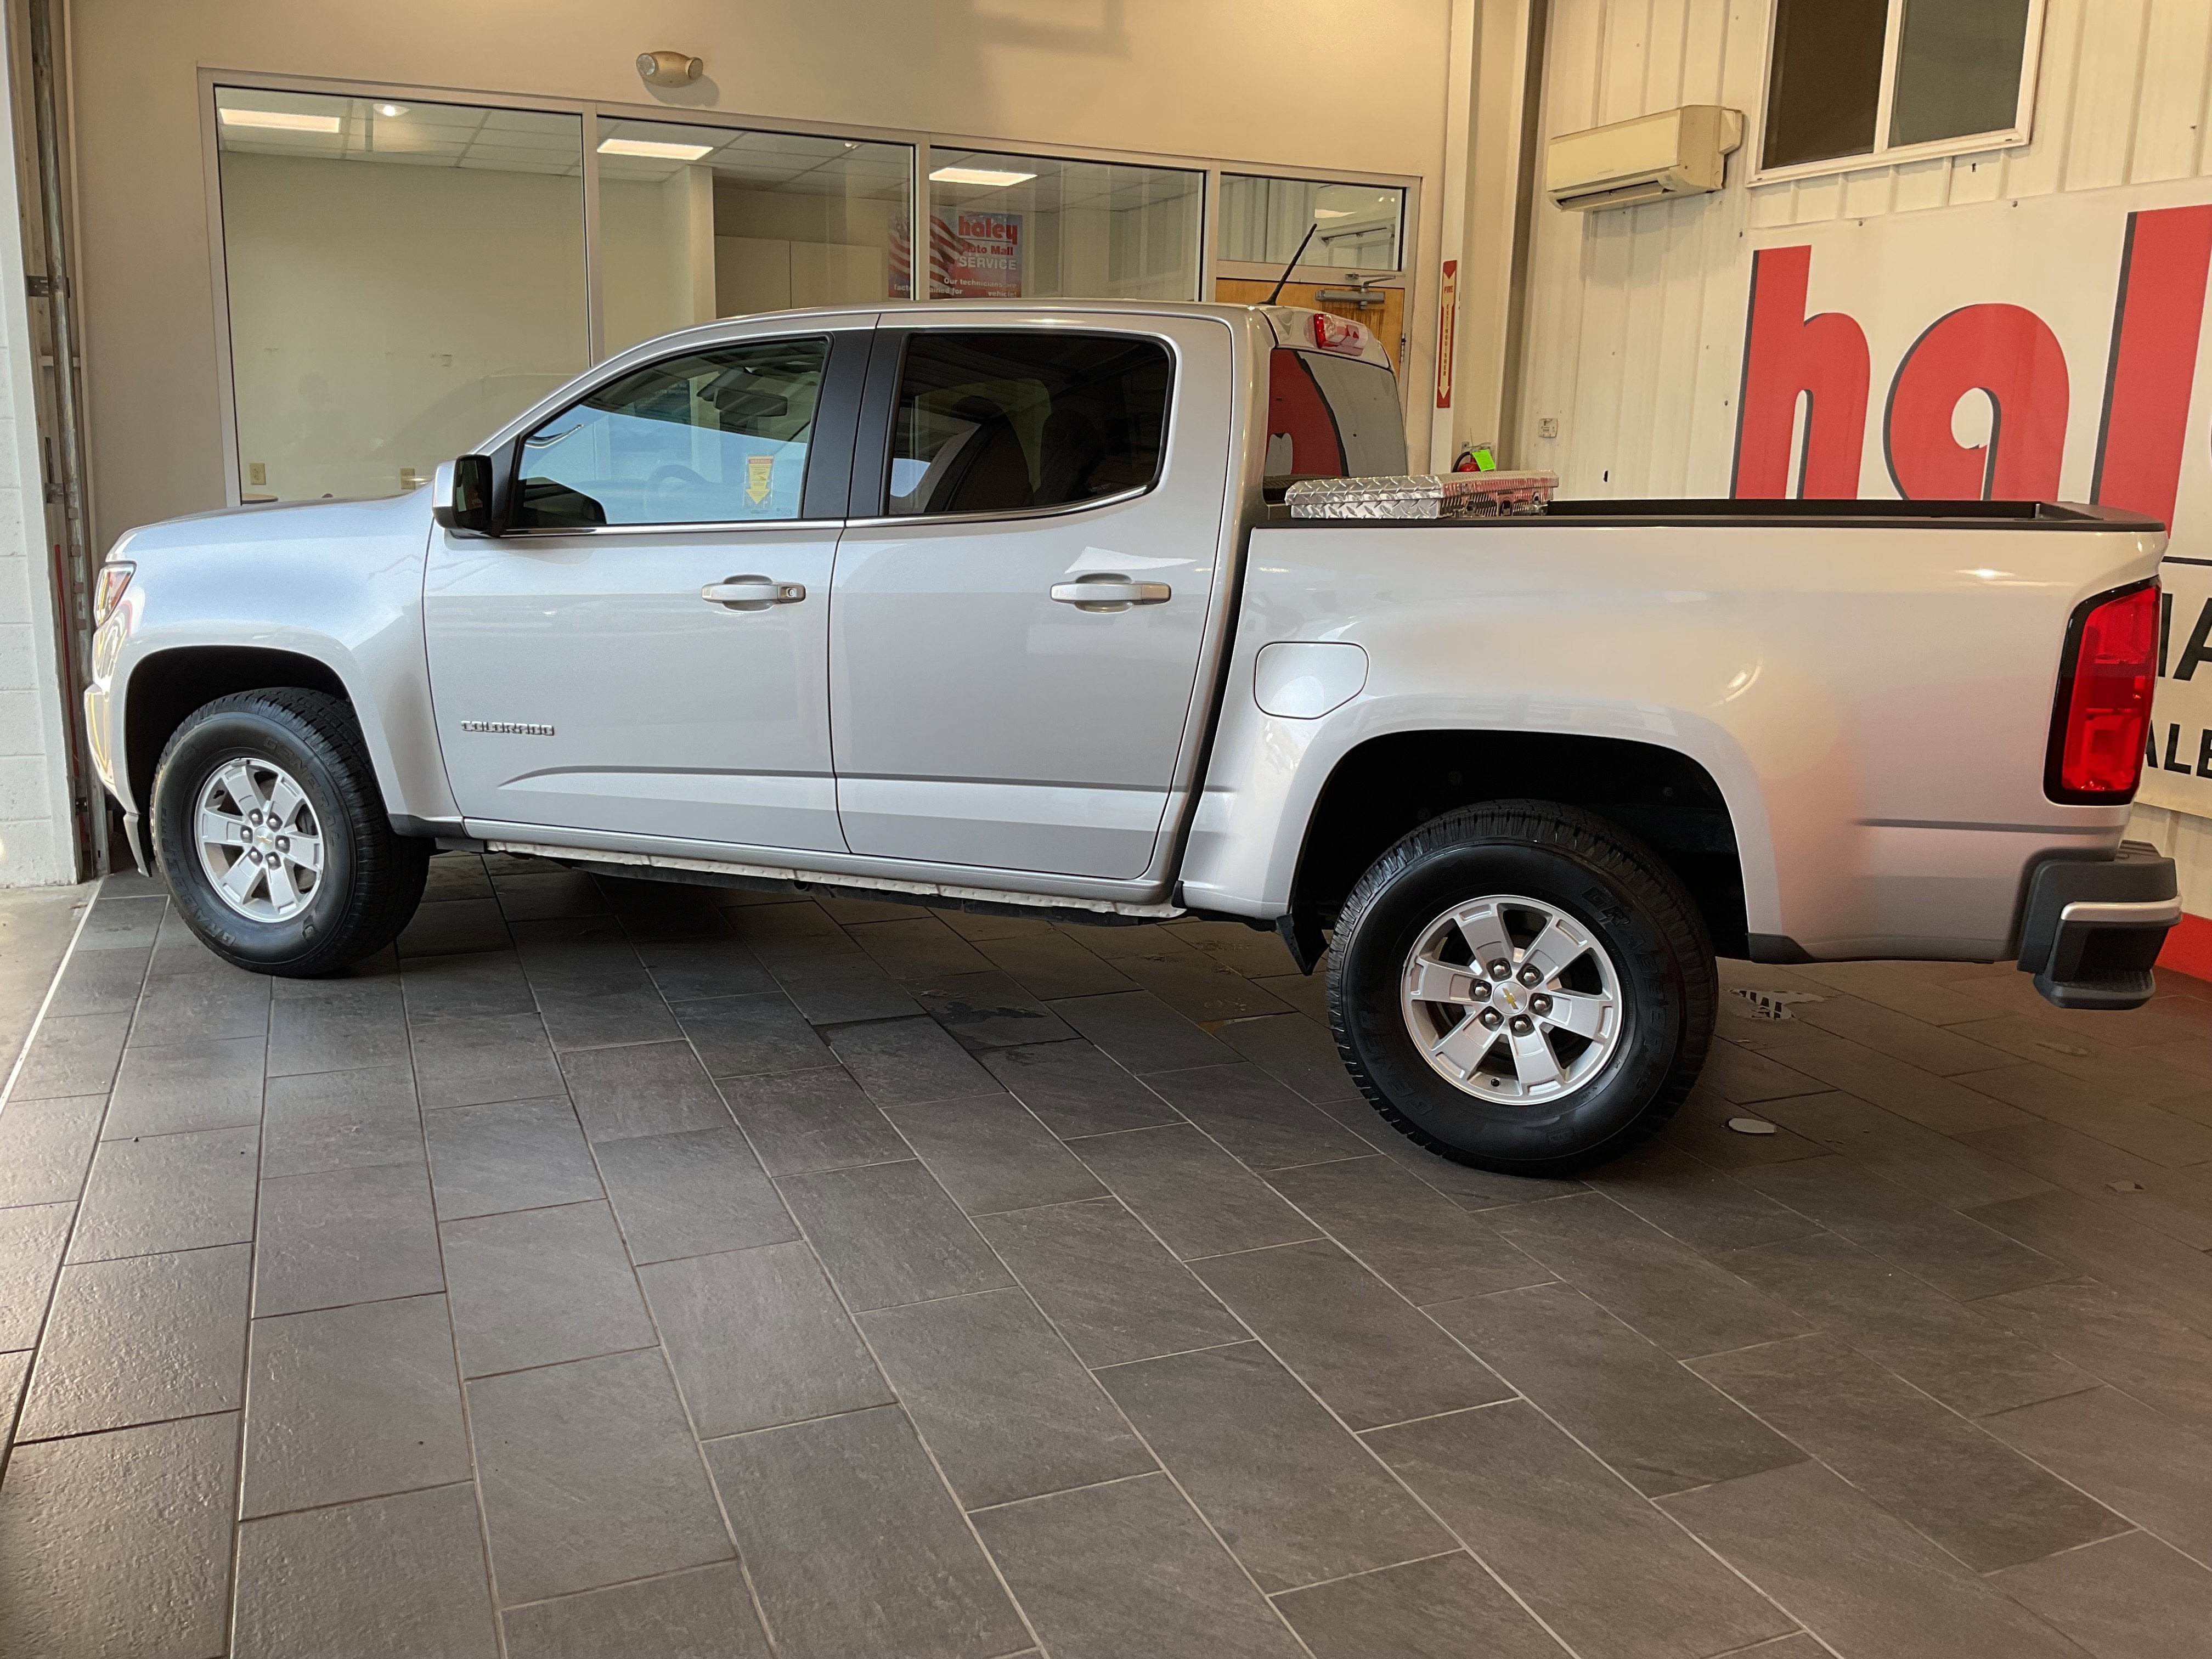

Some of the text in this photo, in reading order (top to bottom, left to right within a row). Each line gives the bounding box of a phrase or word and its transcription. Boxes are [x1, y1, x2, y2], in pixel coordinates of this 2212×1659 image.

[958, 216, 1018, 245] haley
[990, 245, 1014, 256] Mall
[958, 256, 1017, 270] SERVICE
[960, 279, 1003, 287] technicians
[1443, 285, 1453, 294] FIRE
[1729, 204, 2212, 539] hal
[461, 720, 555, 736] COLORADO
[263, 736, 340, 847] GENERAL
[161, 838, 236, 946] GRABBER
[1581, 886, 1667, 1054] GRABBER
